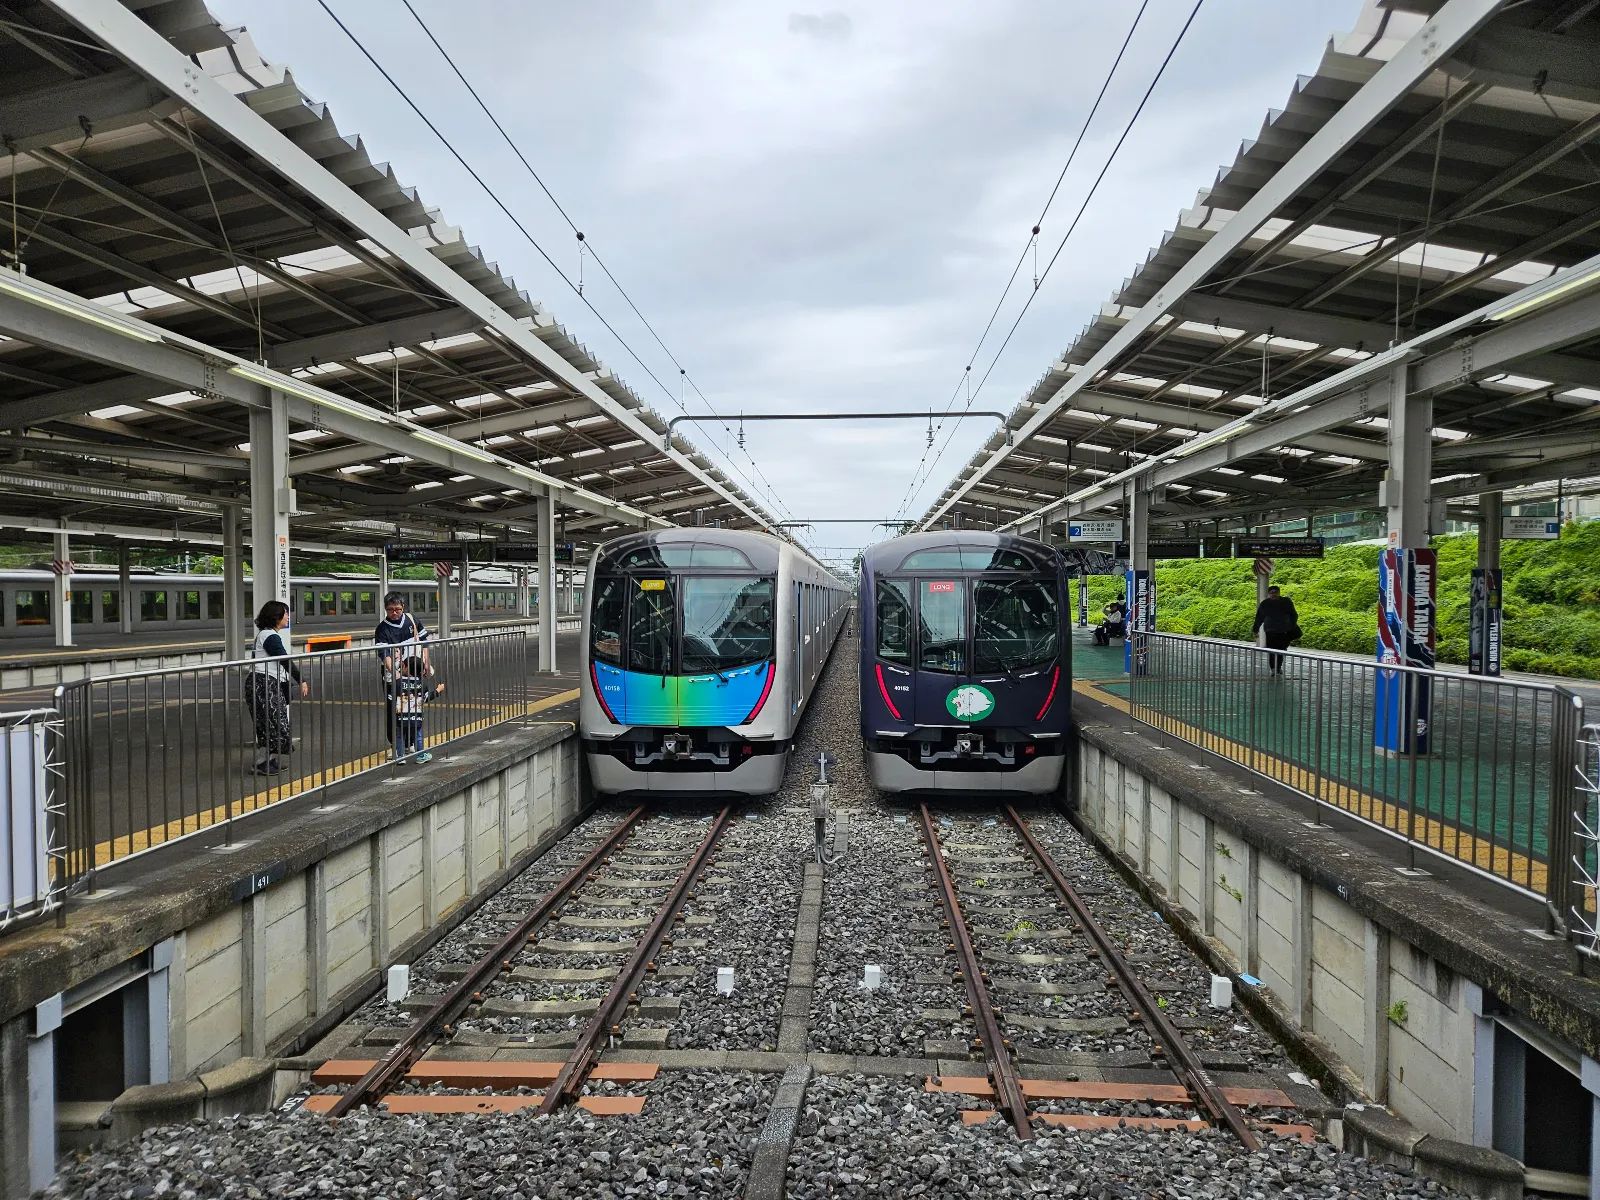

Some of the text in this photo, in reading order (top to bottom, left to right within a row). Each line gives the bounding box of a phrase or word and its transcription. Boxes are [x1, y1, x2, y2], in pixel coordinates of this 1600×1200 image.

[1074, 527, 1080, 535] 2
[1413, 564, 1430, 645] KAIMA TAIRA
[1489, 621, 1498, 662] TYLER NEVIN
[257, 875, 269, 889] 491
